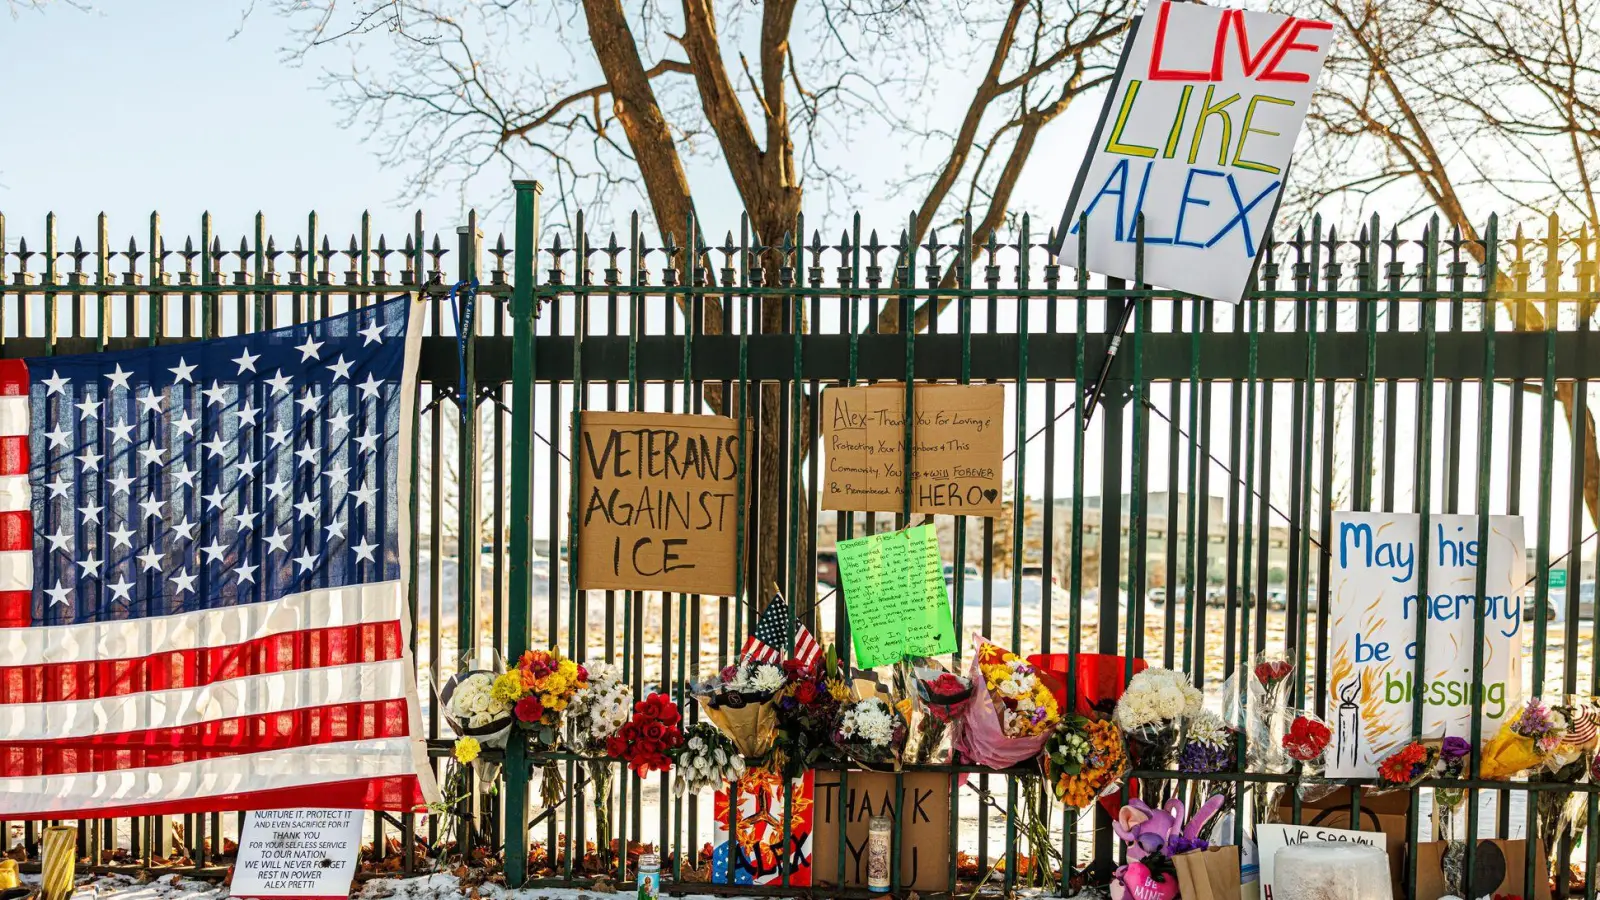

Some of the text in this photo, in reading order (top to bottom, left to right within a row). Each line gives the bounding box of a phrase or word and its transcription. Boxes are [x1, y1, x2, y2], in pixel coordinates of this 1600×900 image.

[1148, 1, 1333, 83] LIVE
[1104, 80, 1295, 174] LIKE
[1070, 159, 1281, 258] ALEX
[915, 410, 931, 426] You
[935, 410, 949, 425] For
[952, 413, 983, 432] Loving
[584, 429, 739, 481] VETERANS
[832, 434, 874, 454] Protecting
[877, 440, 896, 453] Your
[897, 440, 938, 457] Nghbors
[945, 440, 970, 451] This
[884, 463, 902, 477] You
[830, 482, 841, 494] Be
[919, 482, 982, 506] HERO
[584, 485, 734, 531] AGAINST
[614, 536, 695, 576] ICE
[1340, 521, 1479, 583] May his
[861, 635, 880, 645] Rest
[1355, 633, 1391, 663] be
[254, 811, 295, 819] NURTURE
[306, 811, 343, 819] PROTECT
[344, 811, 352, 819] IT
[815, 782, 933, 824] THANK
[273, 831, 320, 839] THANK YOU
[1283, 828, 1309, 846] We
[727, 832, 810, 878] ALEX
[258, 871, 322, 879] REST IN POWER
[1145, 876, 1157, 889] BE
[1134, 885, 1164, 900] MINE
